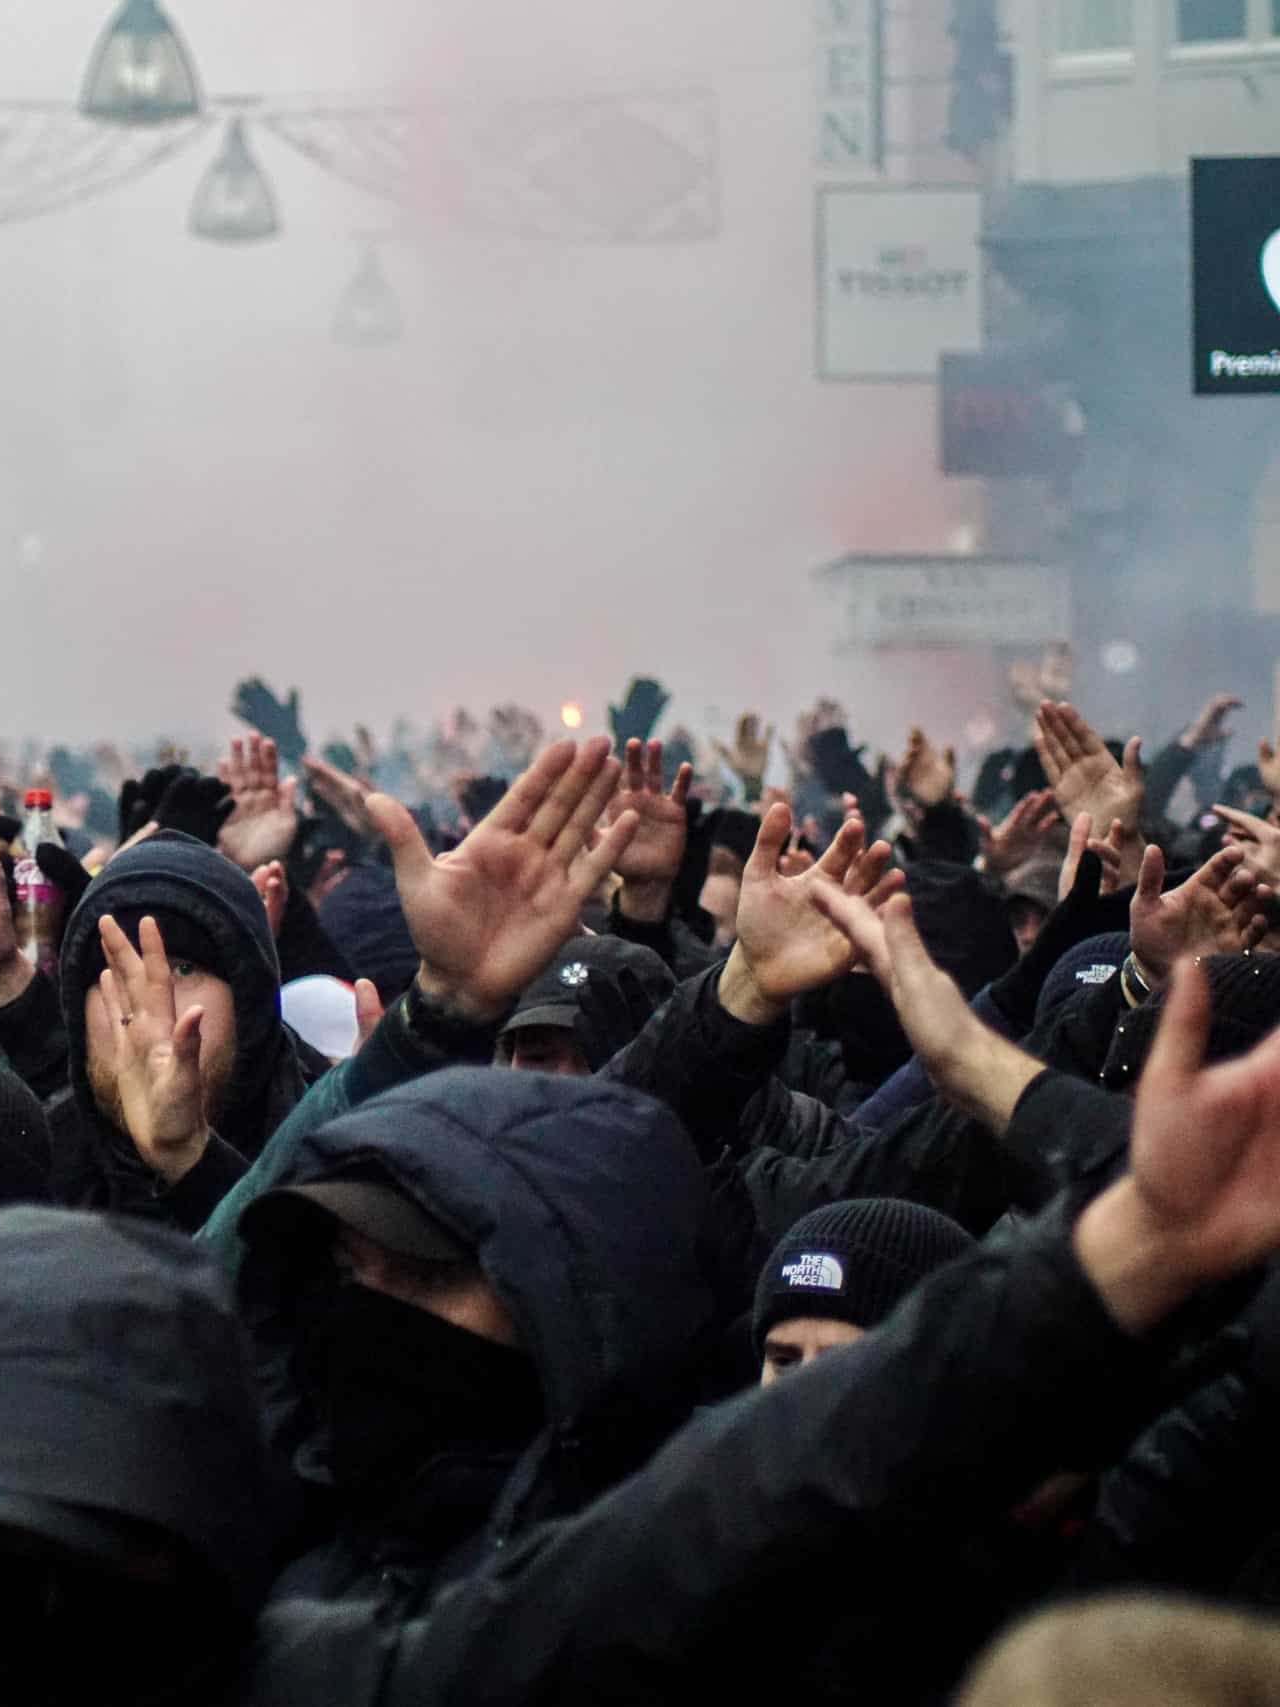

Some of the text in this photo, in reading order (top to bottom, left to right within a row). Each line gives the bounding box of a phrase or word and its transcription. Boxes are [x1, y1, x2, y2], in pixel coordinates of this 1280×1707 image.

[800, 1254, 823, 1265] THE
[782, 1265, 822, 1277] NORTH
[789, 1275, 817, 1286] FACE
